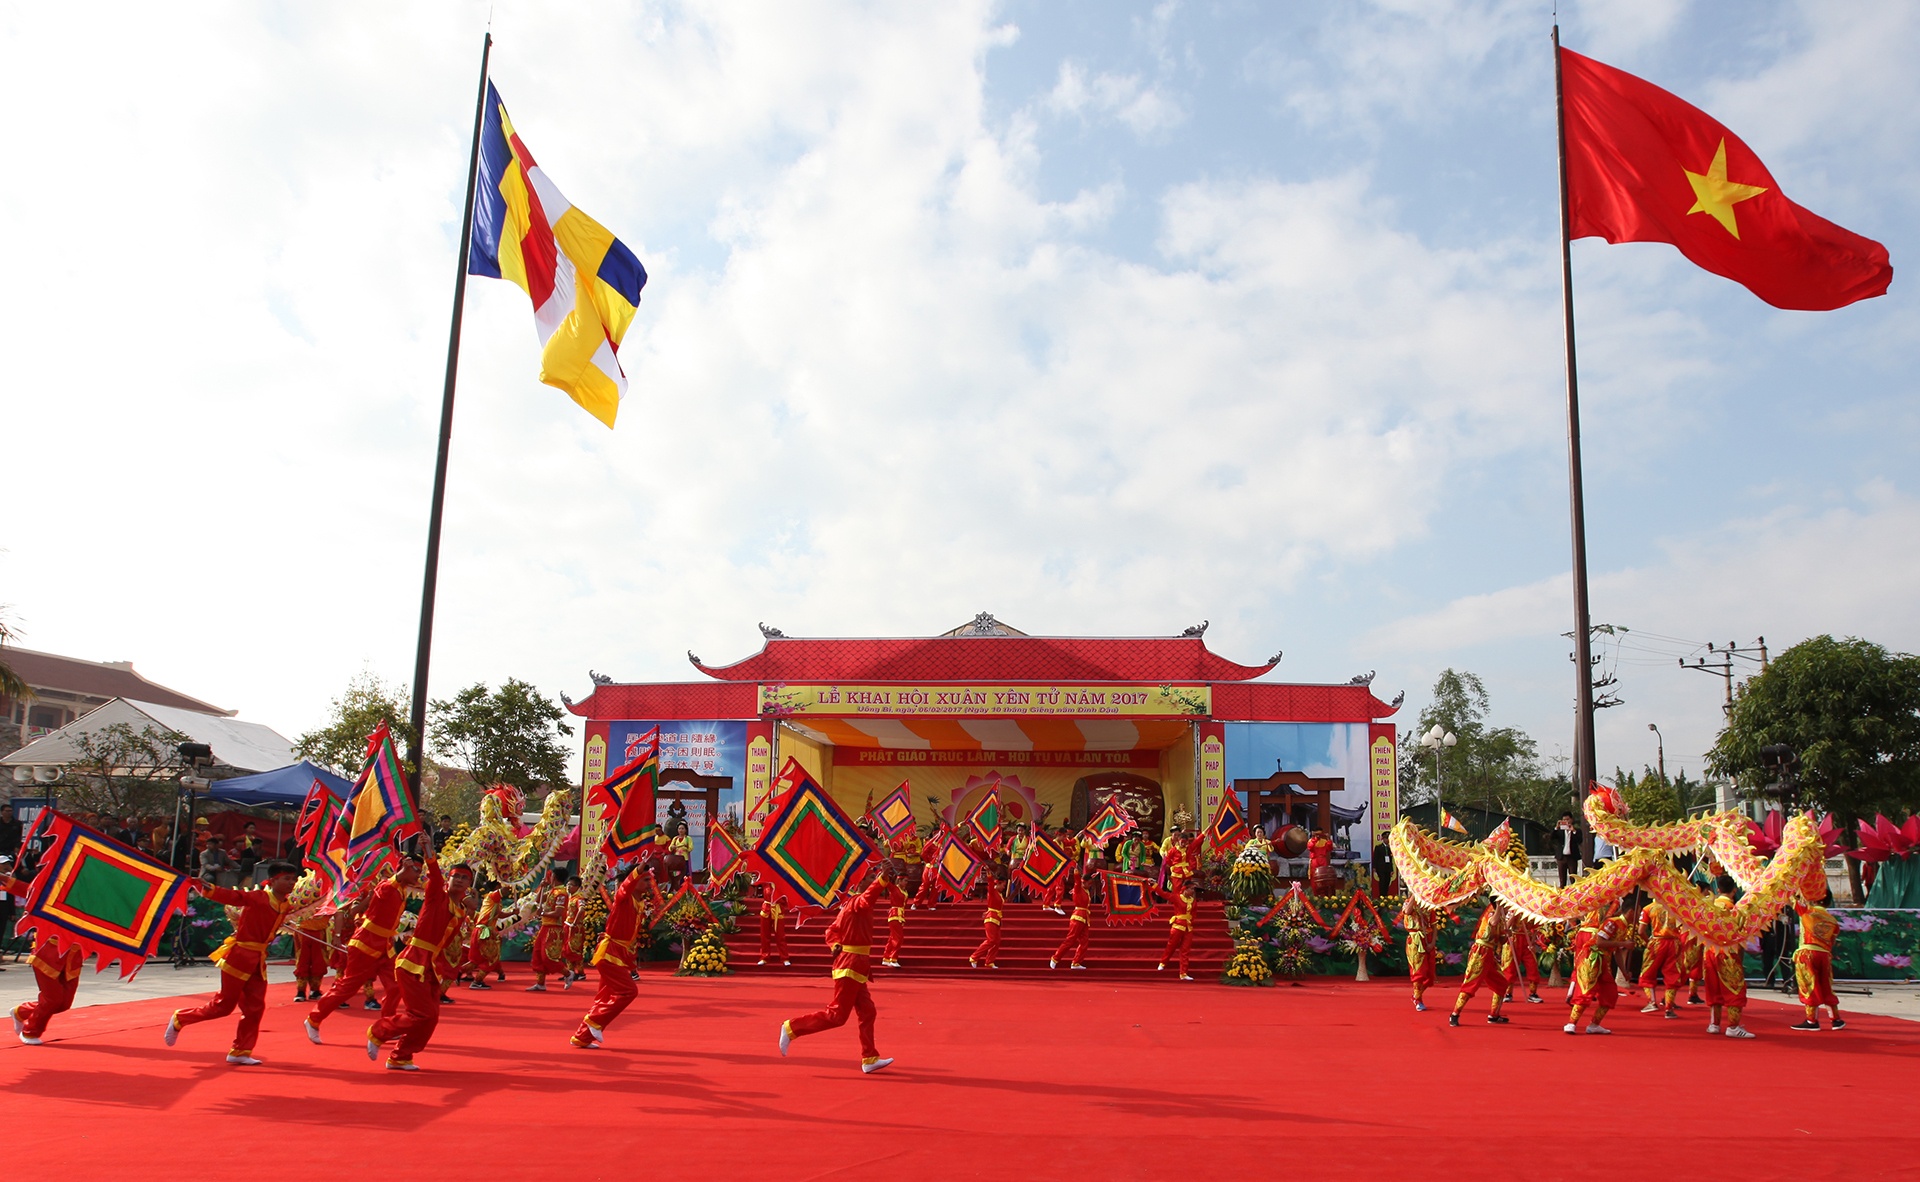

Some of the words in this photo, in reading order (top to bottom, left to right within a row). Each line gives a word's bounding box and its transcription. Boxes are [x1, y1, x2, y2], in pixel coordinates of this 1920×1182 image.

[818, 686, 840, 704] LỄ
[846, 692, 891, 704] KHAI
[897, 689, 929, 707] HỘI
[936, 689, 988, 704] XUÂN
[994, 688, 1031, 705] YÊN
[1036, 687, 1061, 705] TỬ
[1065, 689, 1106, 705] NĂM
[1112, 692, 1149, 705] 2017
[589, 745, 603, 756] PHẬT
[752, 748, 767, 756] THANH
[1204, 742, 1220, 753] CHÍNH
[860, 750, 894, 763] PHẬT
[897, 749, 927, 761] GIÁO
[930, 749, 963, 761] TRÚC
[967, 749, 996, 761] LÂM
[1009, 750, 1030, 764] HỘI
[1033, 751, 1051, 764] TỤ
[1054, 749, 1072, 762] VÀ
[1075, 752, 1102, 763] LAN
[1105, 750, 1131, 763] TỎA
[589, 759, 602, 768] GIÁO
[752, 764, 765, 772] DANH
[1206, 760, 1219, 770] PHÁP
[588, 770, 602, 780] TRÚC
[753, 778, 763, 789] YÊN
[1206, 777, 1219, 788] TRÚC
[1378, 778, 1390, 786] LÂM
[1207, 794, 1218, 805] LÂM
